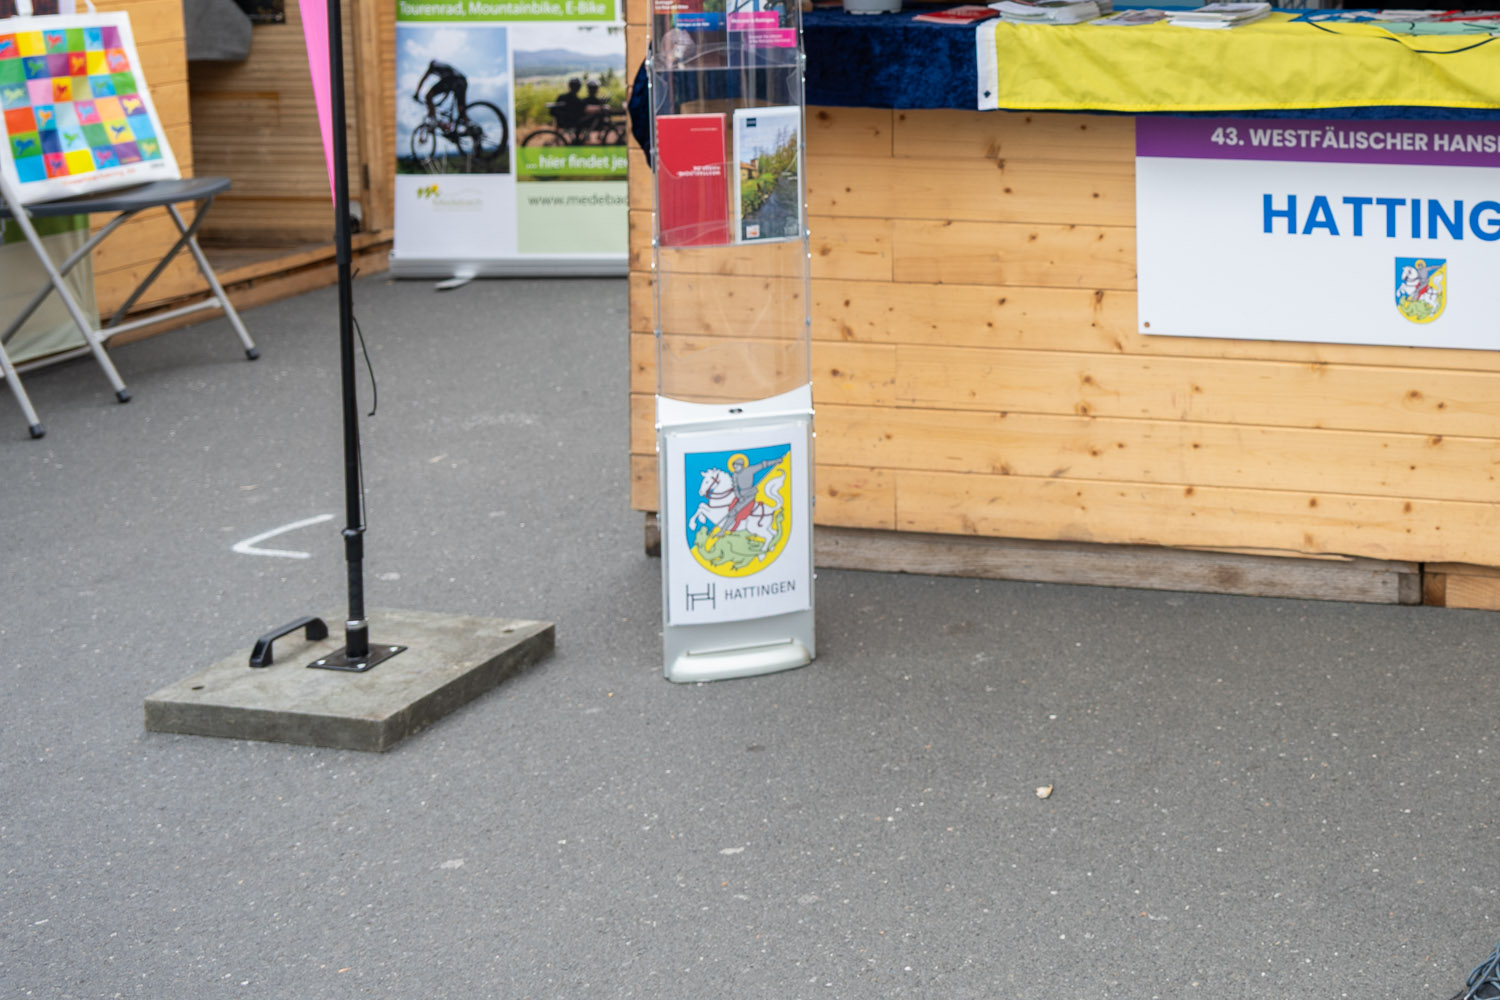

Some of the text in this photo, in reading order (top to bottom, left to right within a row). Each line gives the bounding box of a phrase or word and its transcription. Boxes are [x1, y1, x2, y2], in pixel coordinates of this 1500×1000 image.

[1211, 127, 1245, 146] 43.
[1249, 125, 1428, 152] WESTFÄLISCHER
[539, 154, 566, 169] hier
[568, 154, 609, 169] findet
[724, 579, 796, 600] HATTINGEN
